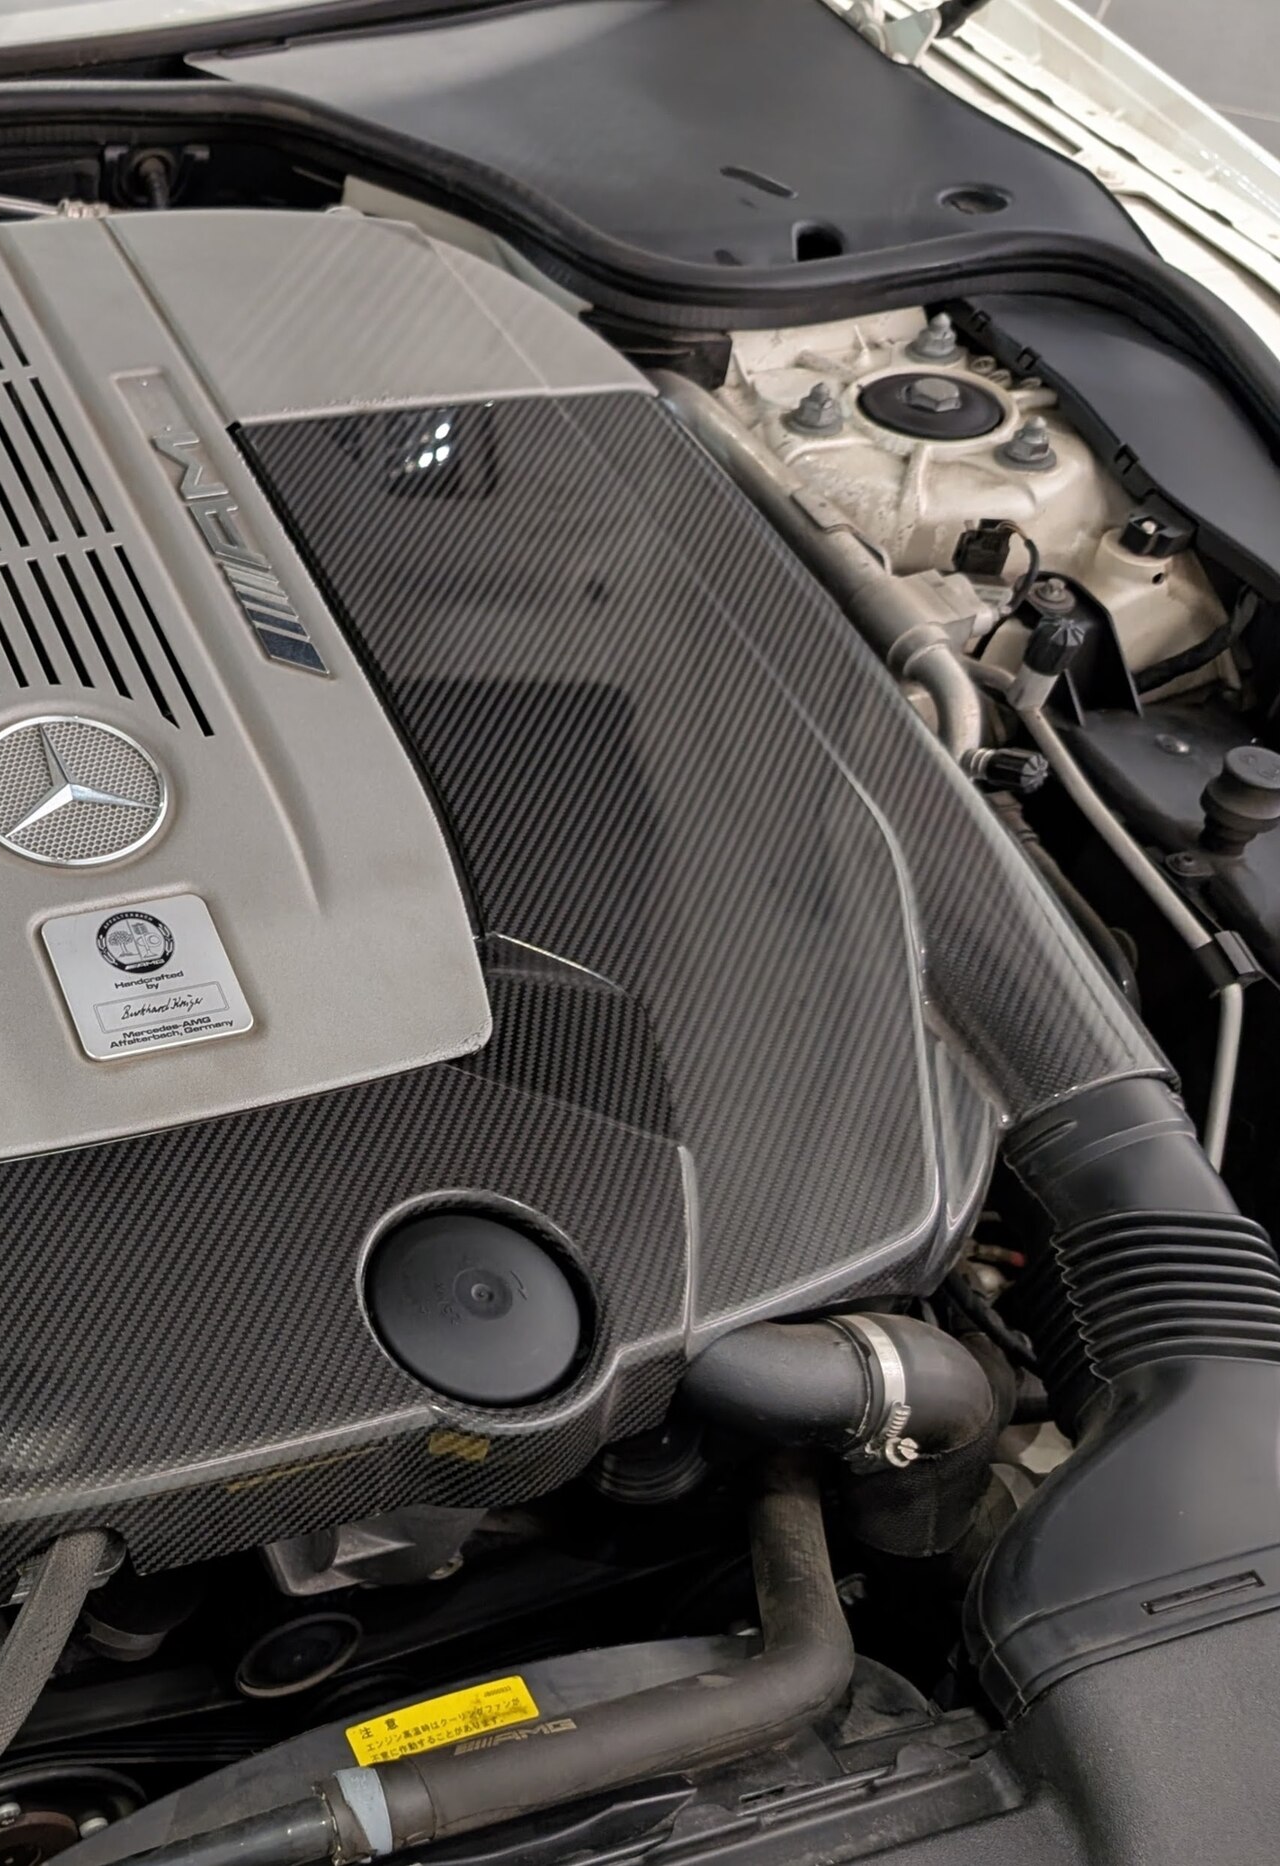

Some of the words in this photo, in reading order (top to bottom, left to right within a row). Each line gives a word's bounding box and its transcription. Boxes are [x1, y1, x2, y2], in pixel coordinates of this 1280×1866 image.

[114, 970, 184, 990] Handcrafted
[145, 983, 160, 991] by
[109, 1029, 183, 1049] Affalterbach,
[183, 1019, 234, 1035] Germany
[122, 1016, 212, 1039] Mercedes-AMG
